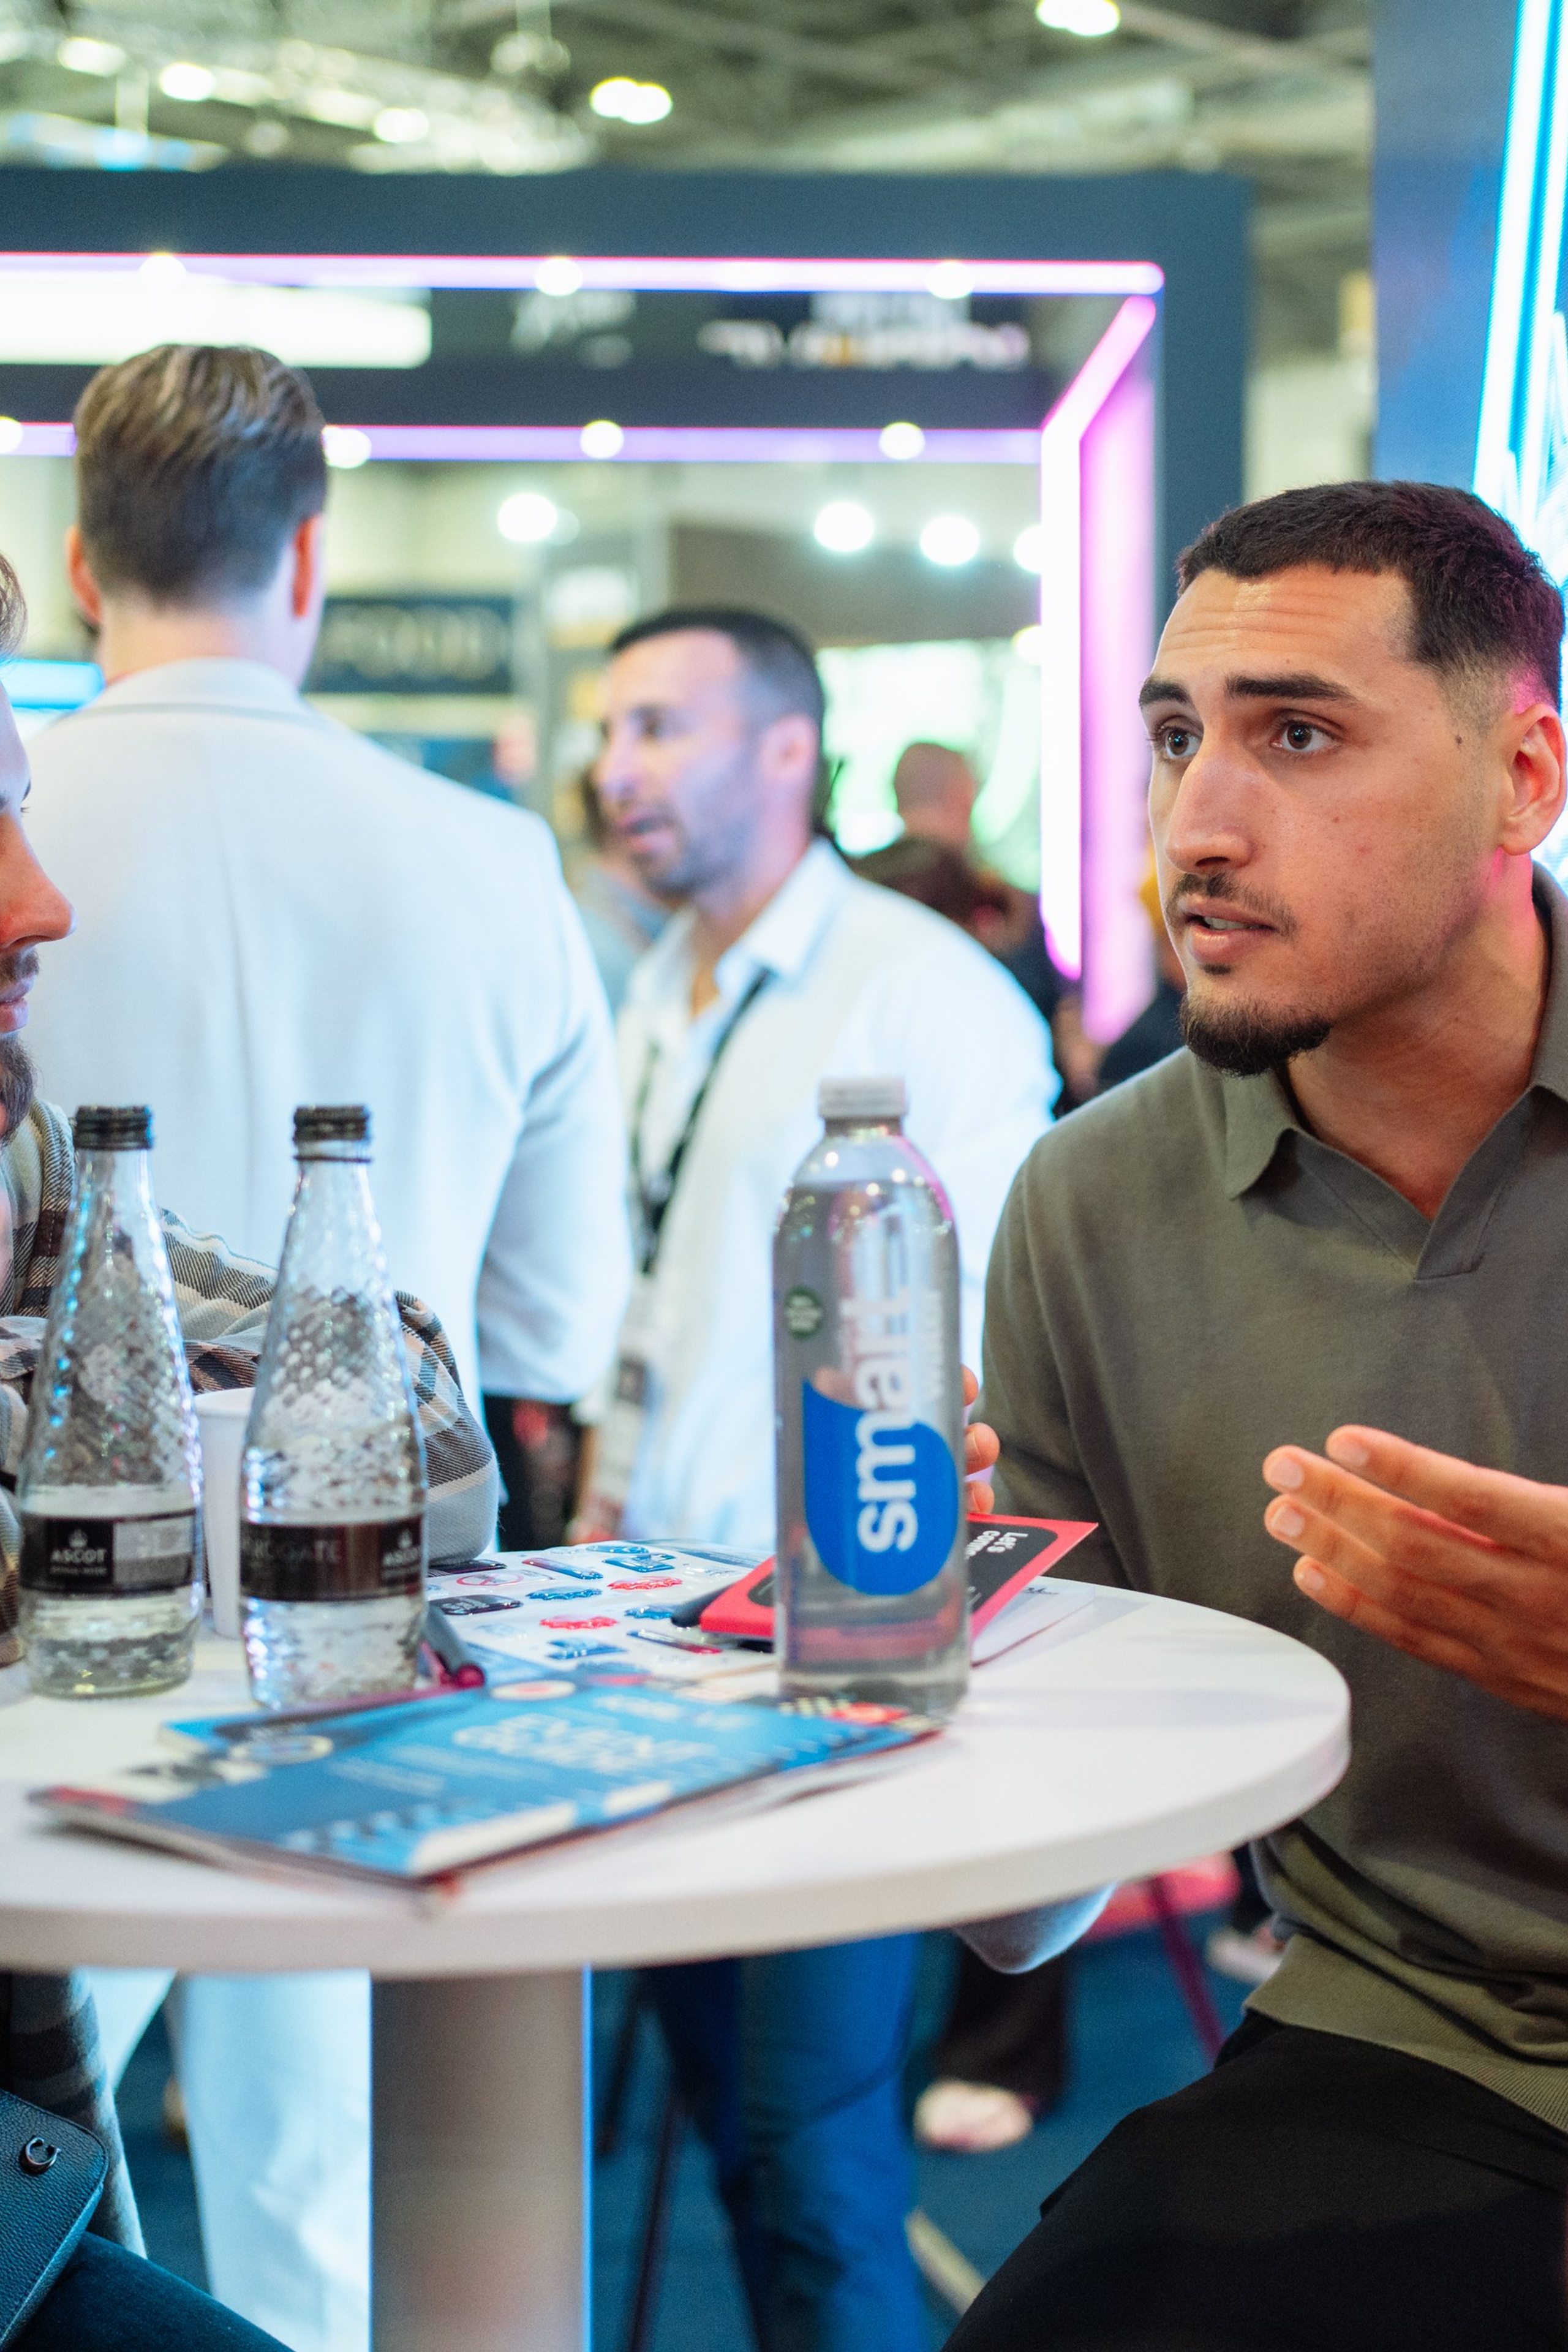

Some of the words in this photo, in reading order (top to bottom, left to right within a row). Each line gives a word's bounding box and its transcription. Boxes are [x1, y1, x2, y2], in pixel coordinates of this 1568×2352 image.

[838, 1285, 919, 1554] smart
[50, 1548, 107, 1564] ASCOT
[965, 1530, 1001, 1559] conne
